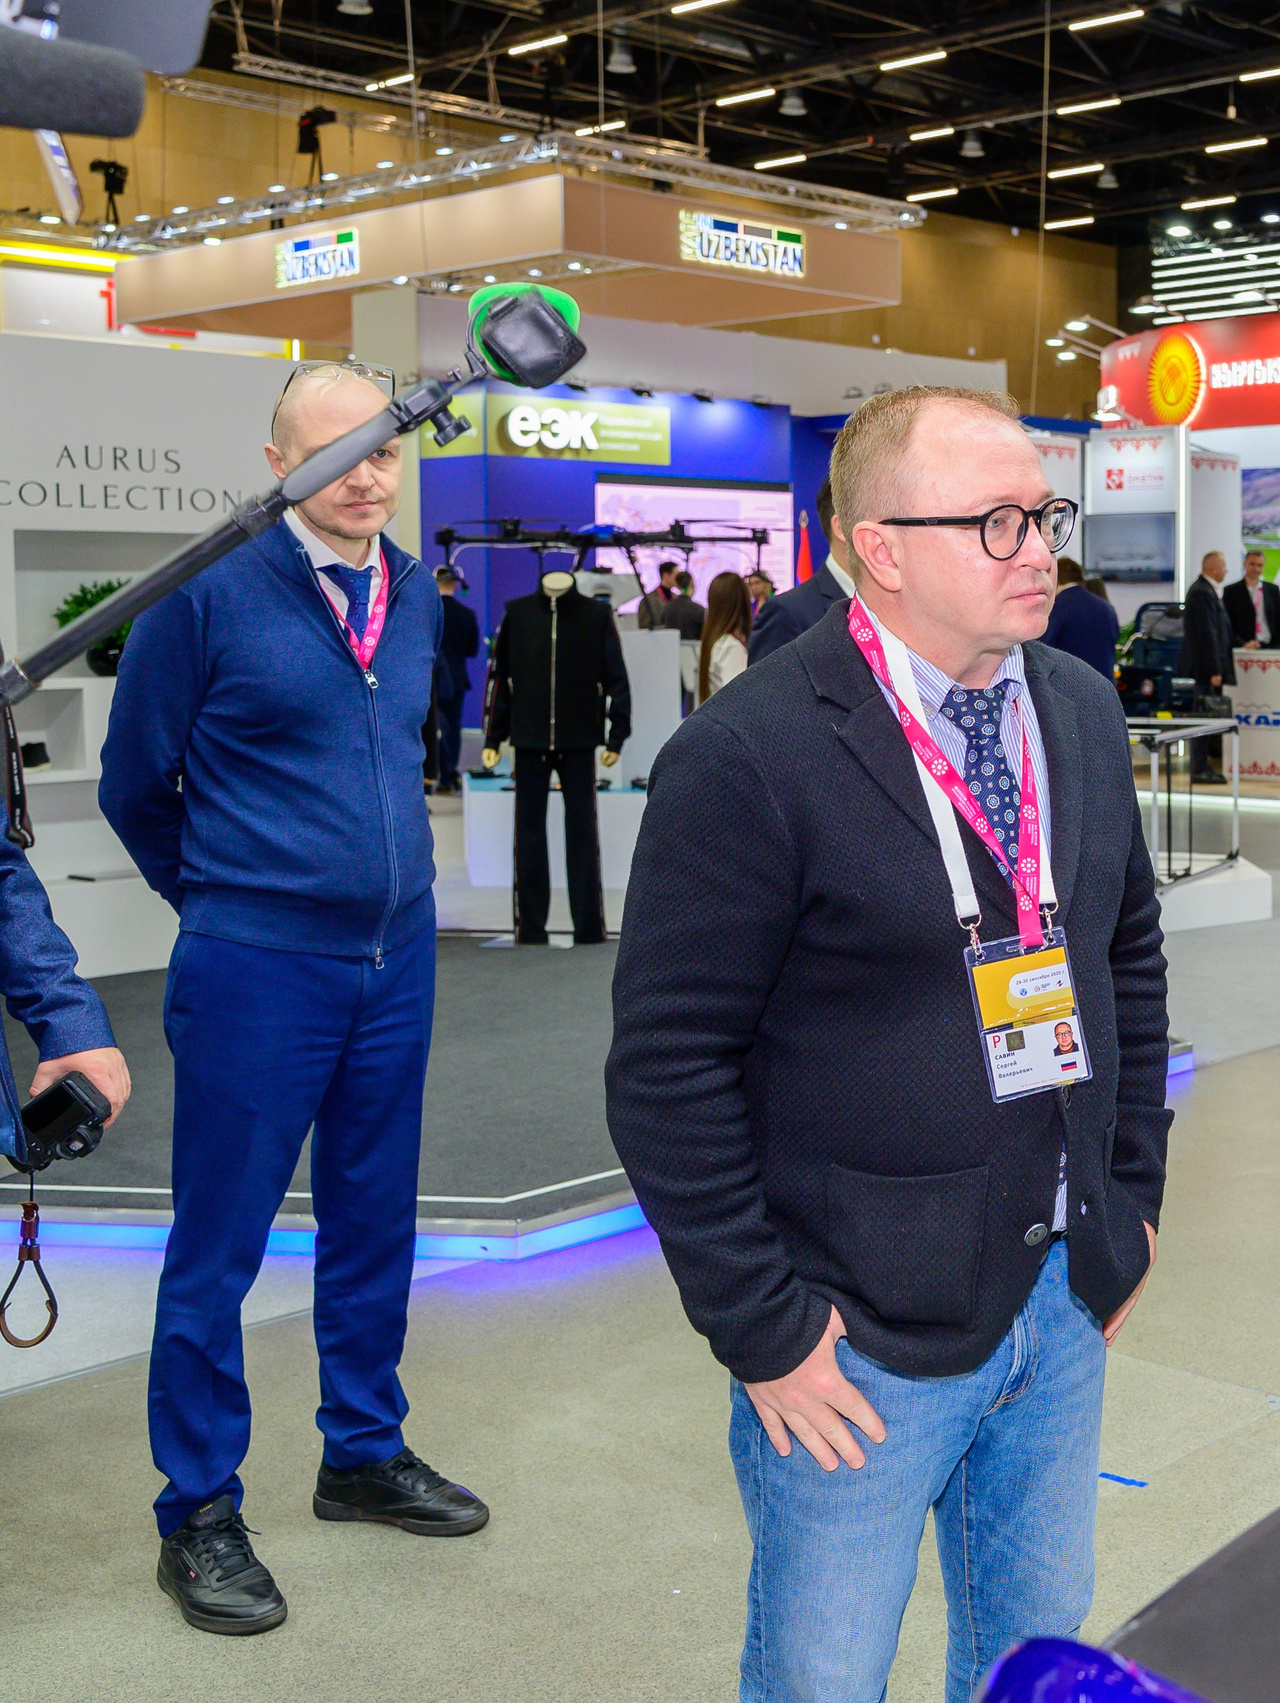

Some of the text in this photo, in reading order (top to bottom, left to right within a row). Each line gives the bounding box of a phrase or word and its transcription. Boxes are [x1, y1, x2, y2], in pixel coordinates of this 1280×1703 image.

[697, 230, 804, 277] UZBEKISTAN
[56, 445, 181, 474] AURUS
[1029, 973, 1051, 982] сентября
[995, 1052, 1015, 1060] САВИН
[997, 1061, 1017, 1070] Сергей
[998, 1068, 1033, 1078] Валерьевич
